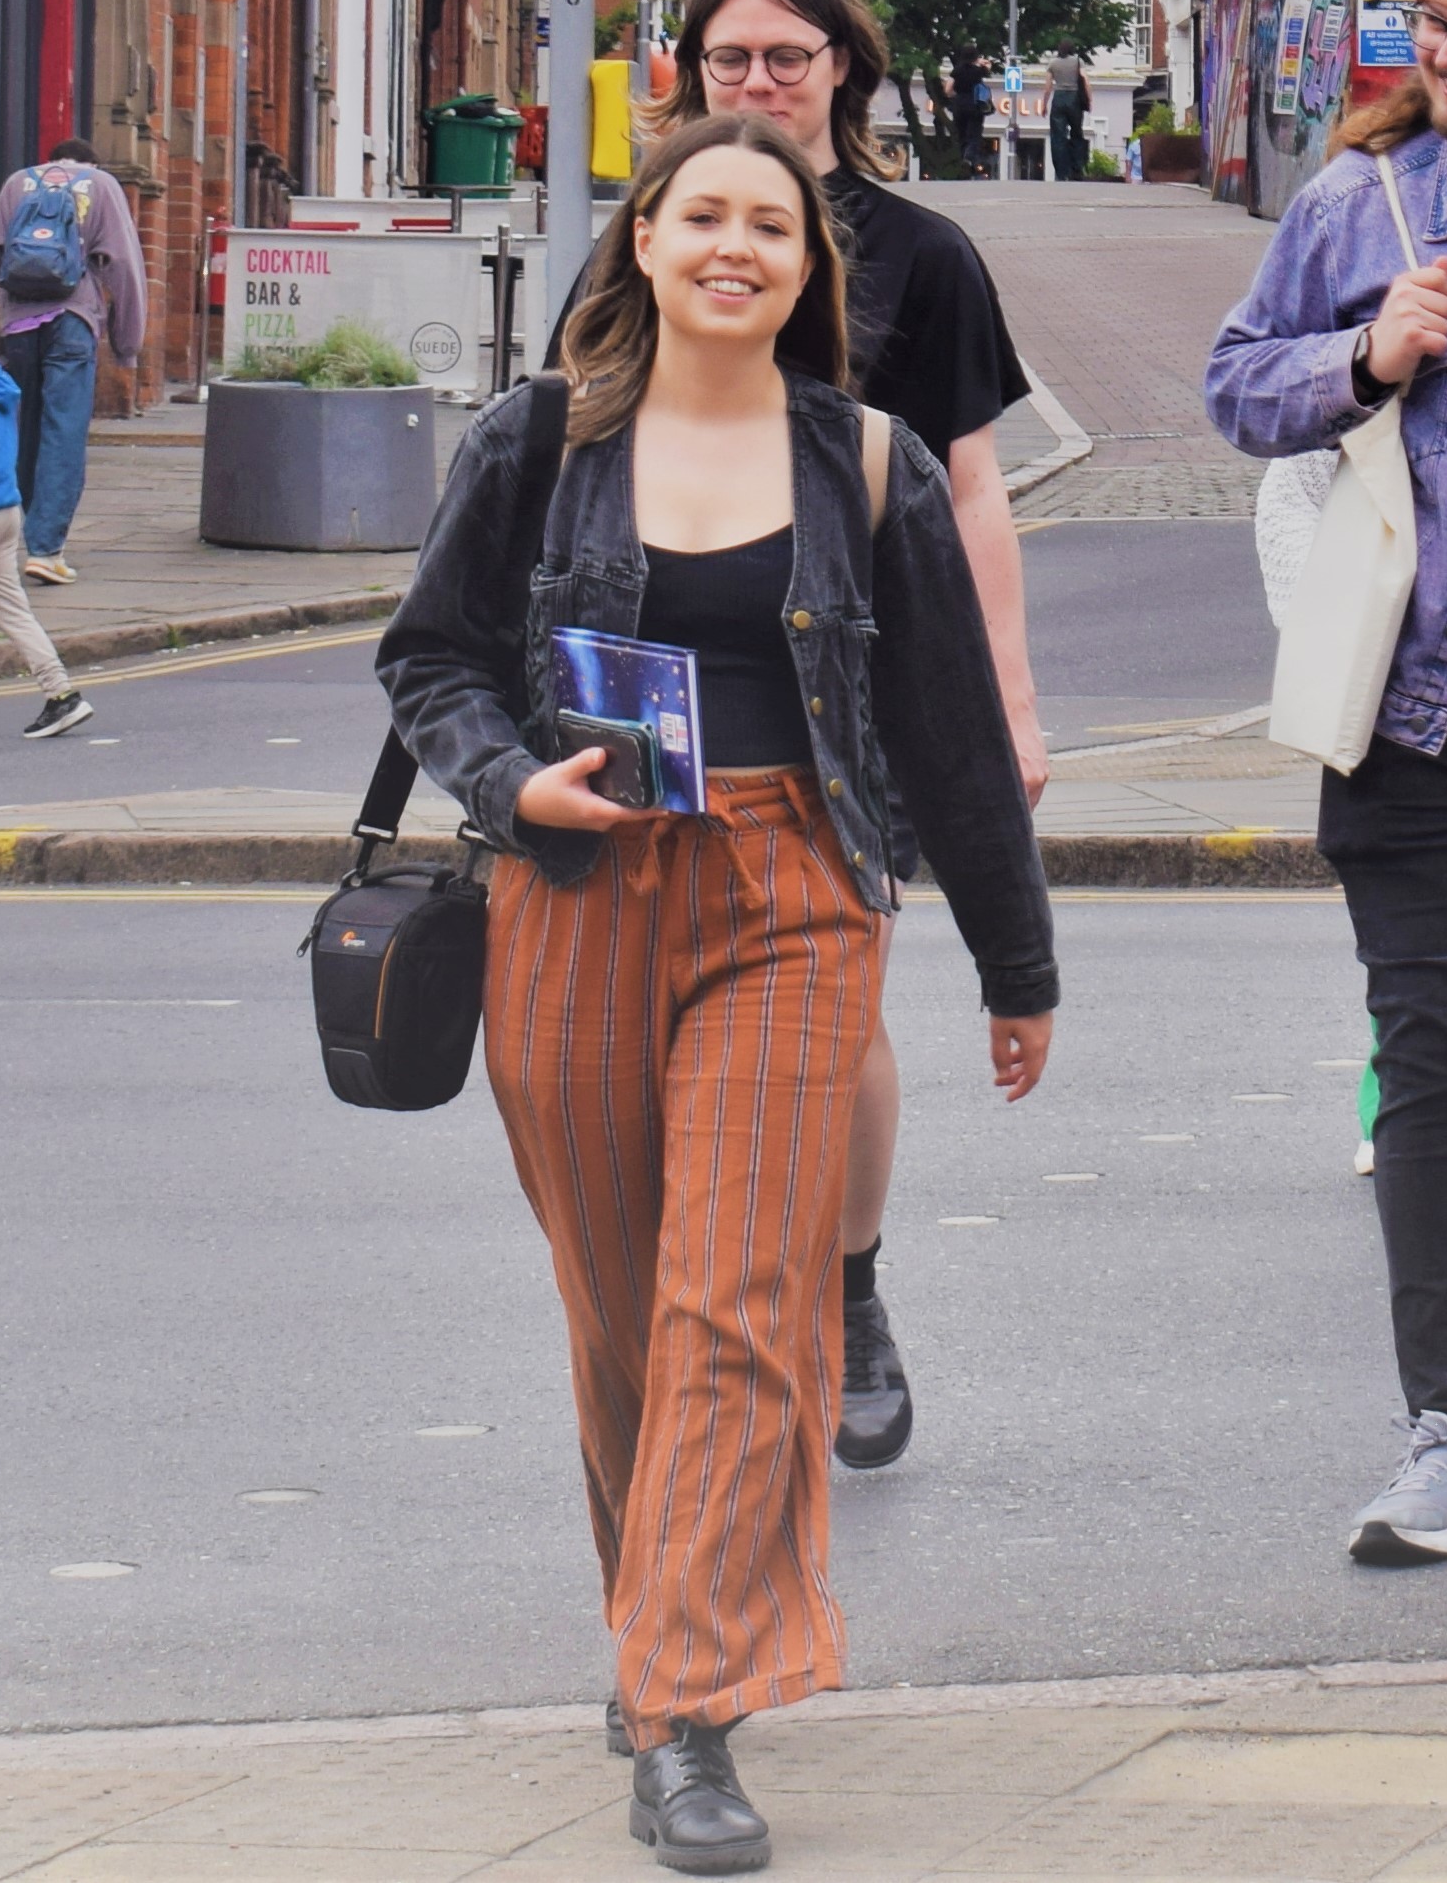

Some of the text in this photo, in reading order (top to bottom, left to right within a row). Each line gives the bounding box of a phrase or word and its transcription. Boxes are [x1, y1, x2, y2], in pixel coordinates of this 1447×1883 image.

[1377, 31, 1403, 39] visitors
[1376, 49, 1398, 58] report
[246, 249, 331, 275] COCKTAIL
[246, 281, 301, 306] BAR &
[244, 312, 296, 338] PIZZA
[414, 341, 457, 355] SUEDE
